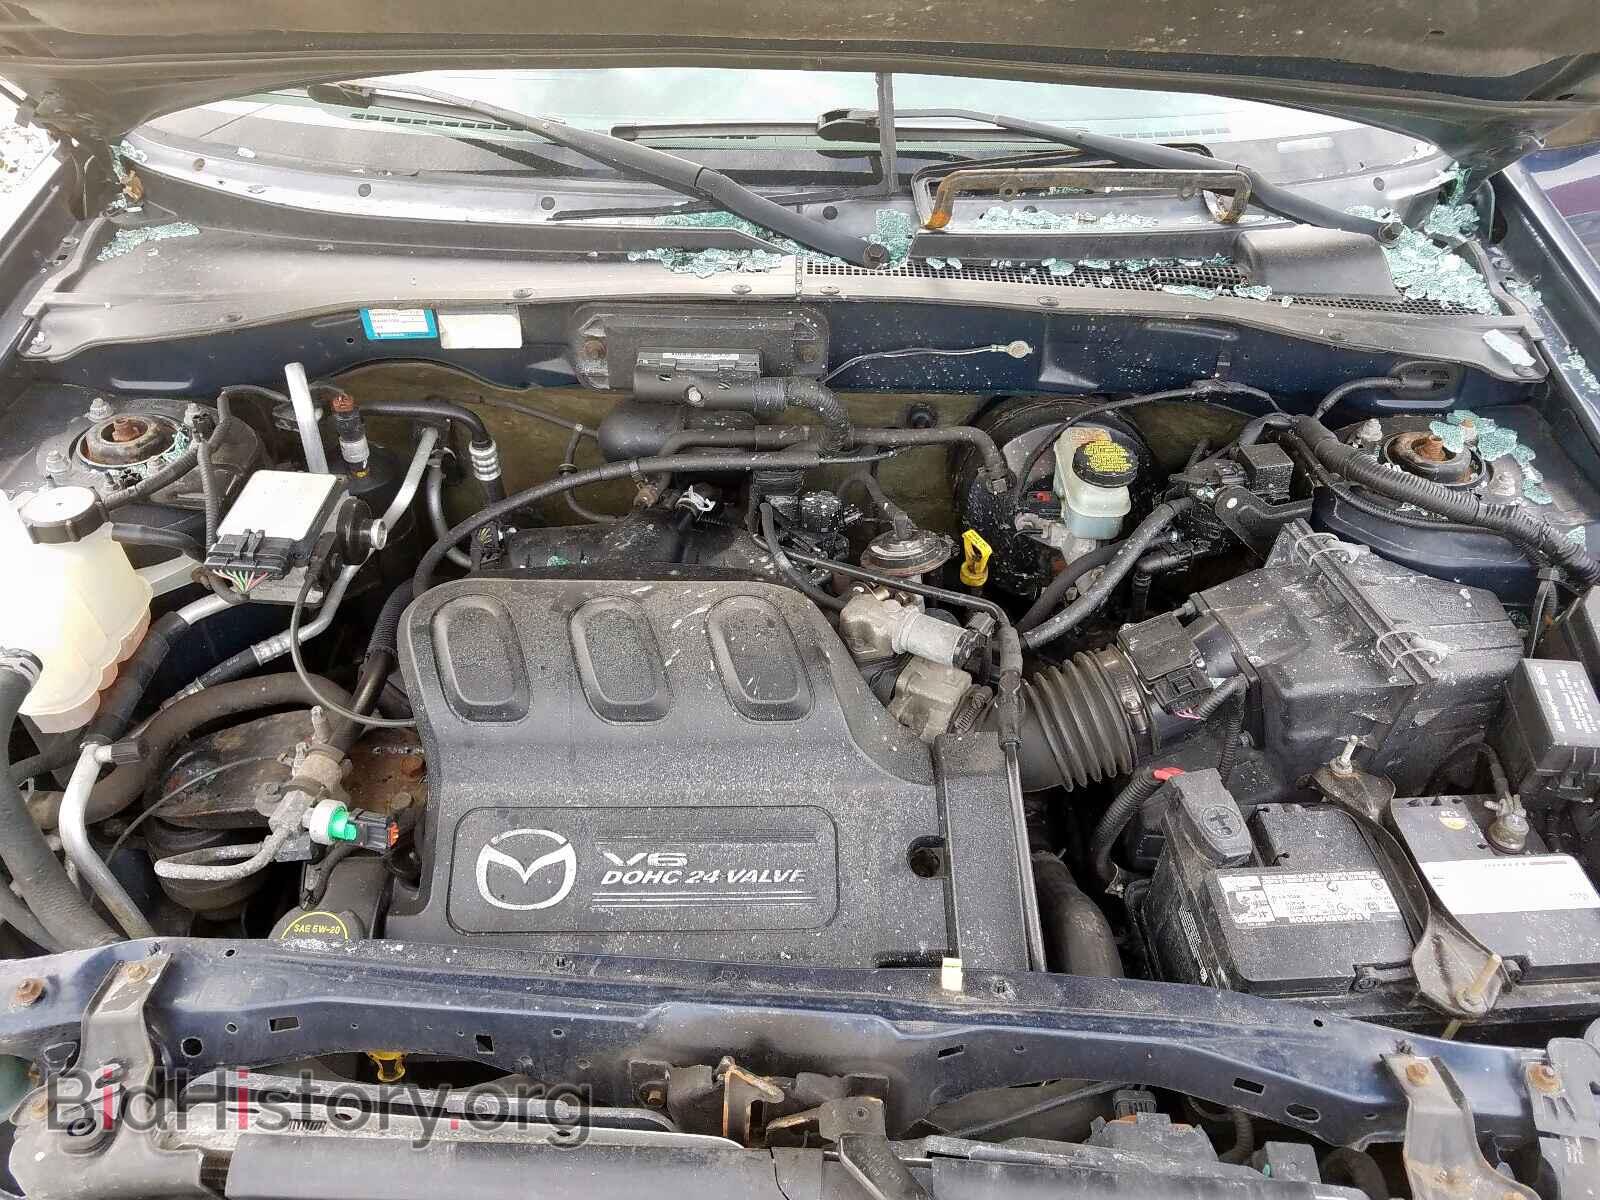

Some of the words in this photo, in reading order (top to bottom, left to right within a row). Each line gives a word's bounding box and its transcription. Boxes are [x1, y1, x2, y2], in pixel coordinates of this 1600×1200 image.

[602, 852, 688, 867] V6
[601, 870, 682, 885] DOHC
[293, 923, 311, 933] SAE
[312, 924, 341, 935] 5W-20
